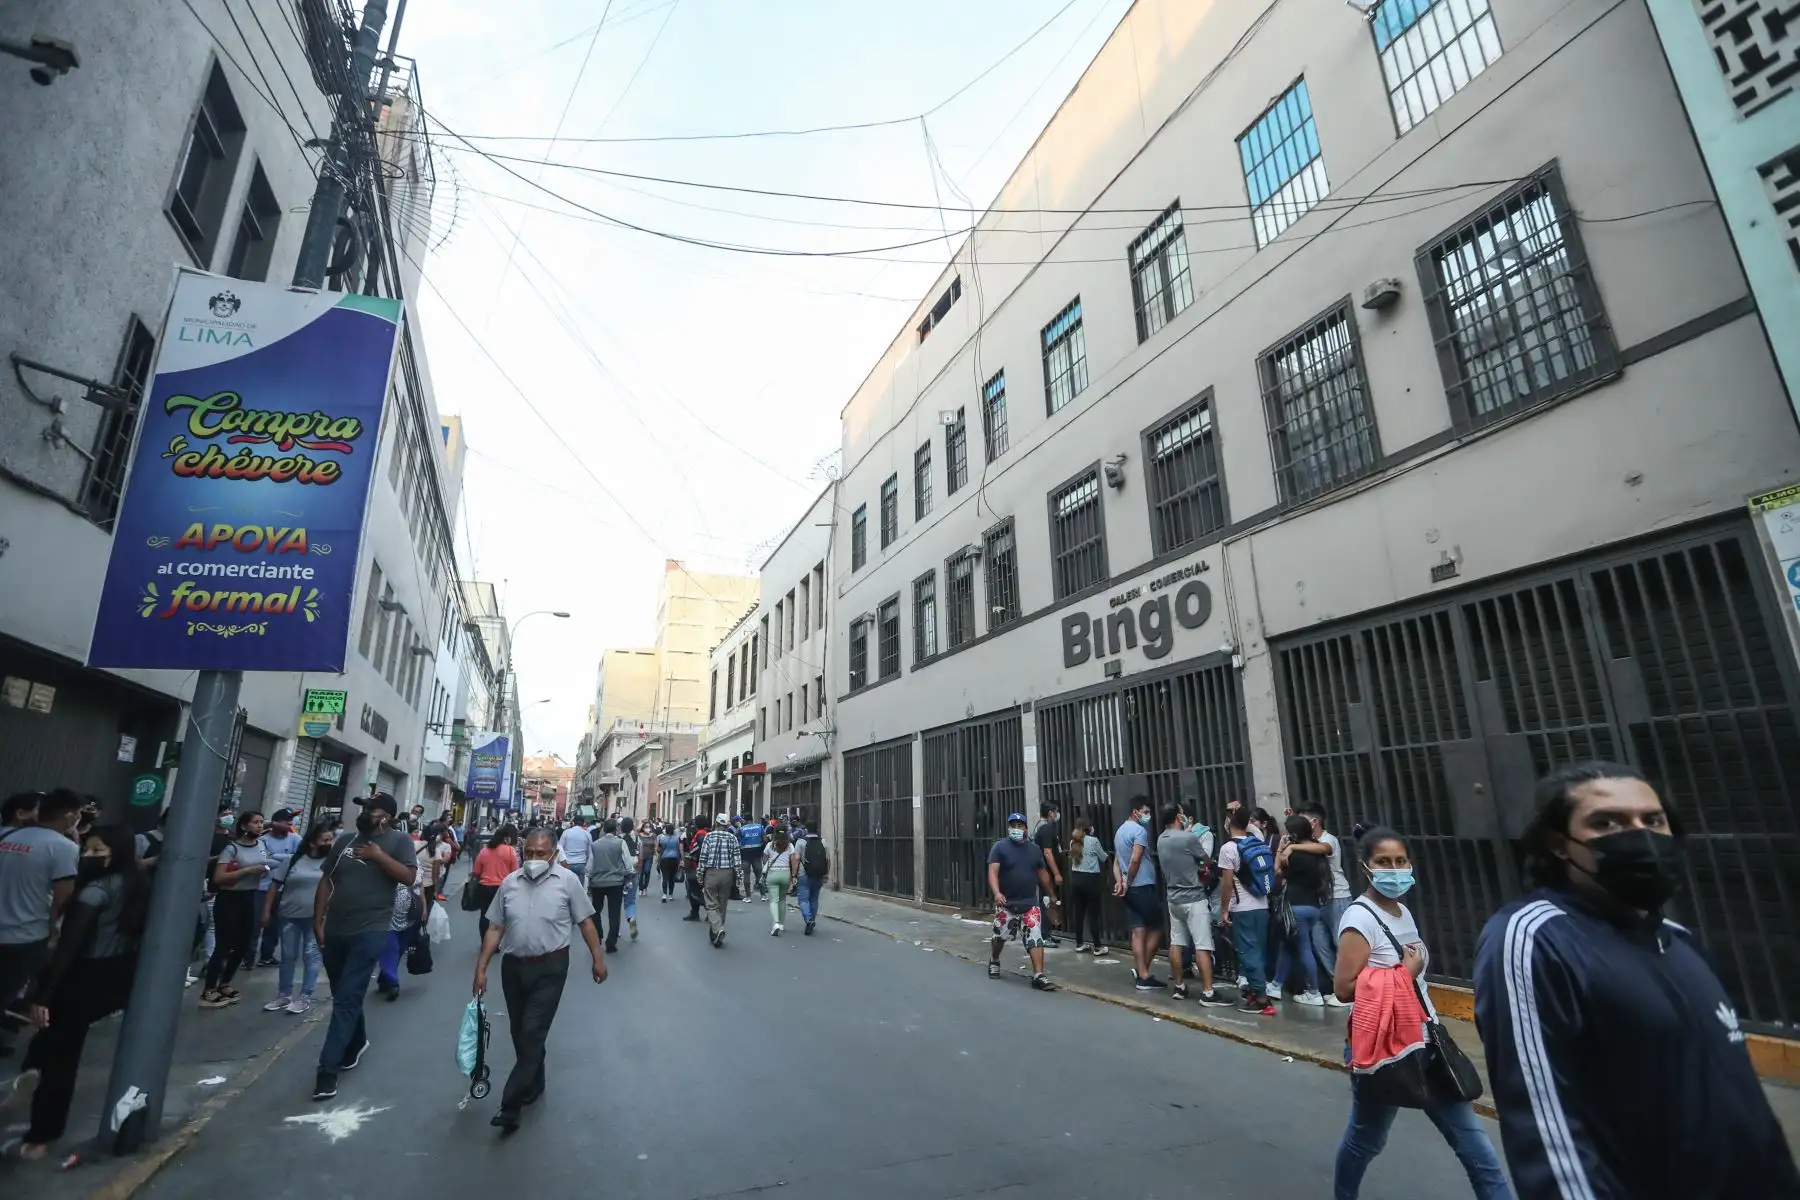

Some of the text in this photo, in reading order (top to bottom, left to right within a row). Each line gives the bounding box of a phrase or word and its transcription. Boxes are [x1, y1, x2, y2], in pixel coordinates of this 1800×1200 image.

[179, 326, 253, 347] LIMA
[183, 317, 246, 329] MUNICIPALIDAD
[164, 390, 363, 444] Compra
[171, 443, 343, 485] chévere
[173, 522, 309, 556] APOYA
[157, 561, 315, 580] al comerciante
[1149, 560, 1210, 592] COMERCIAL
[157, 580, 302, 619] formal
[1061, 579, 1212, 668] Bingo
